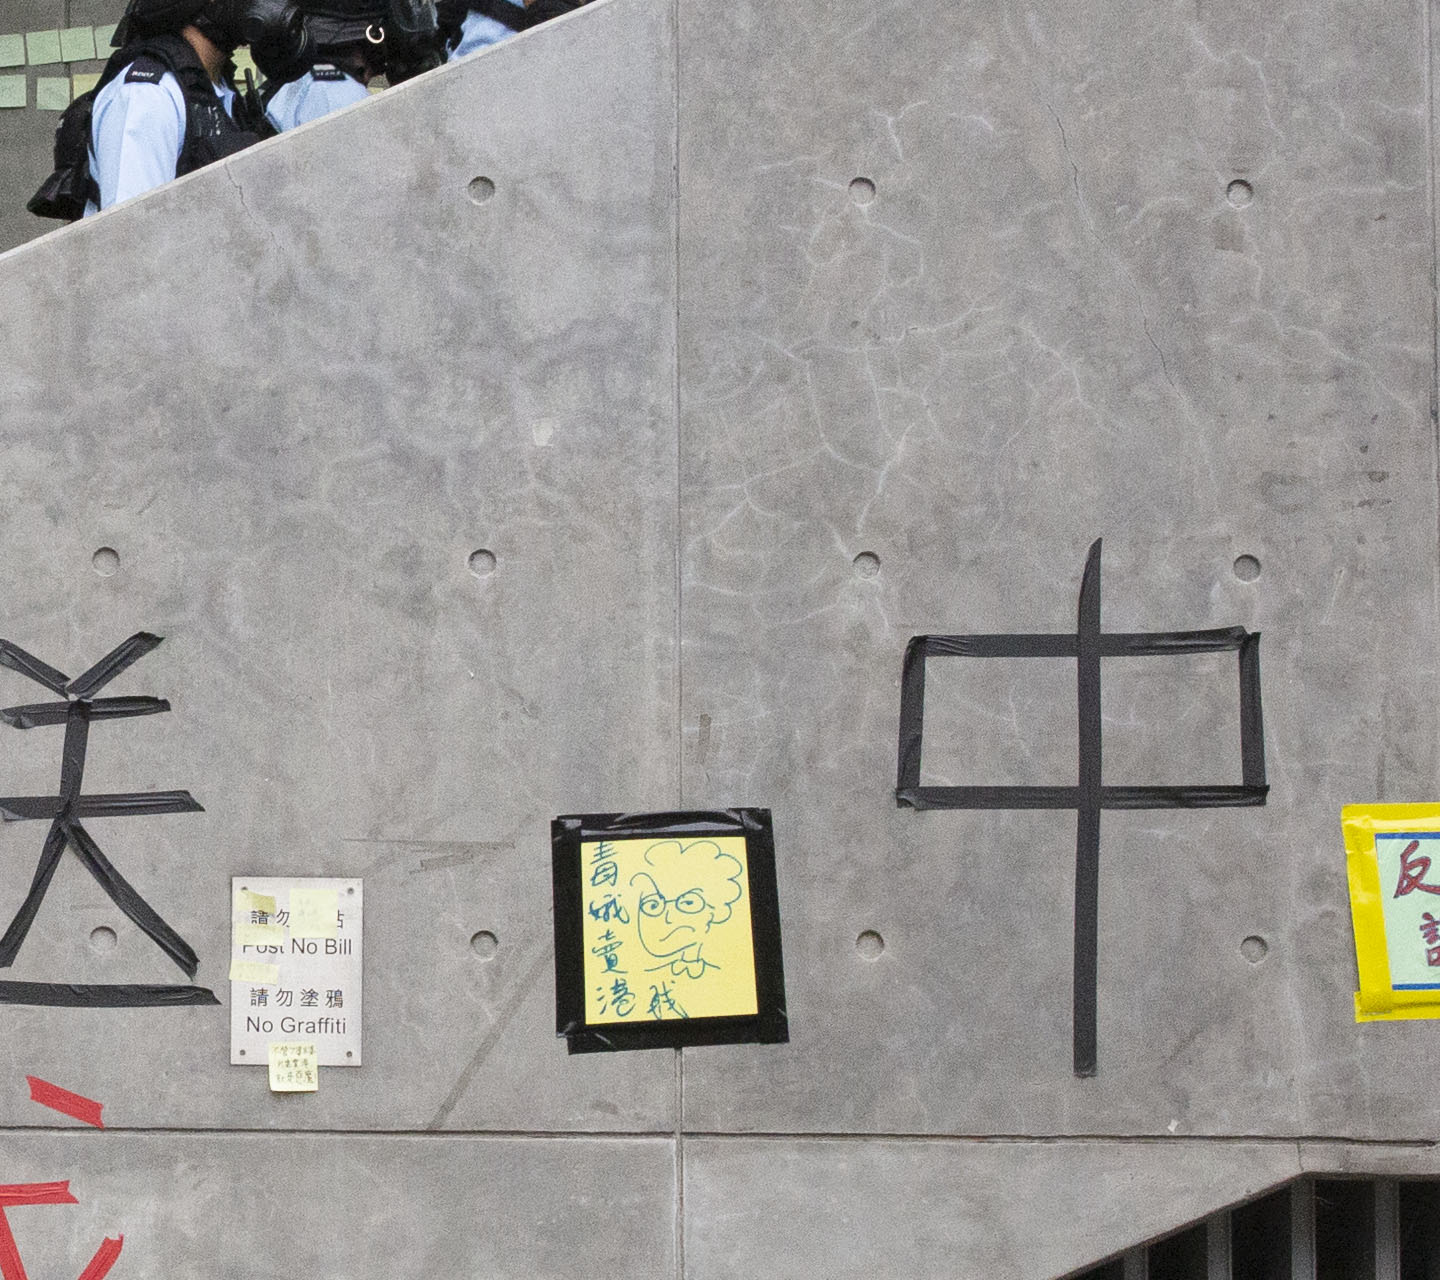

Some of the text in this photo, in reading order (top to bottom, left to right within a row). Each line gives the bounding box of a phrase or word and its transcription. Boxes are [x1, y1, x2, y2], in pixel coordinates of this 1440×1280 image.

[291, 938, 318, 955] No
[324, 937, 352, 956] Bill
[249, 987, 345, 1010] 請勿塗鴉
[246, 1016, 347, 1035] No Graffiti
